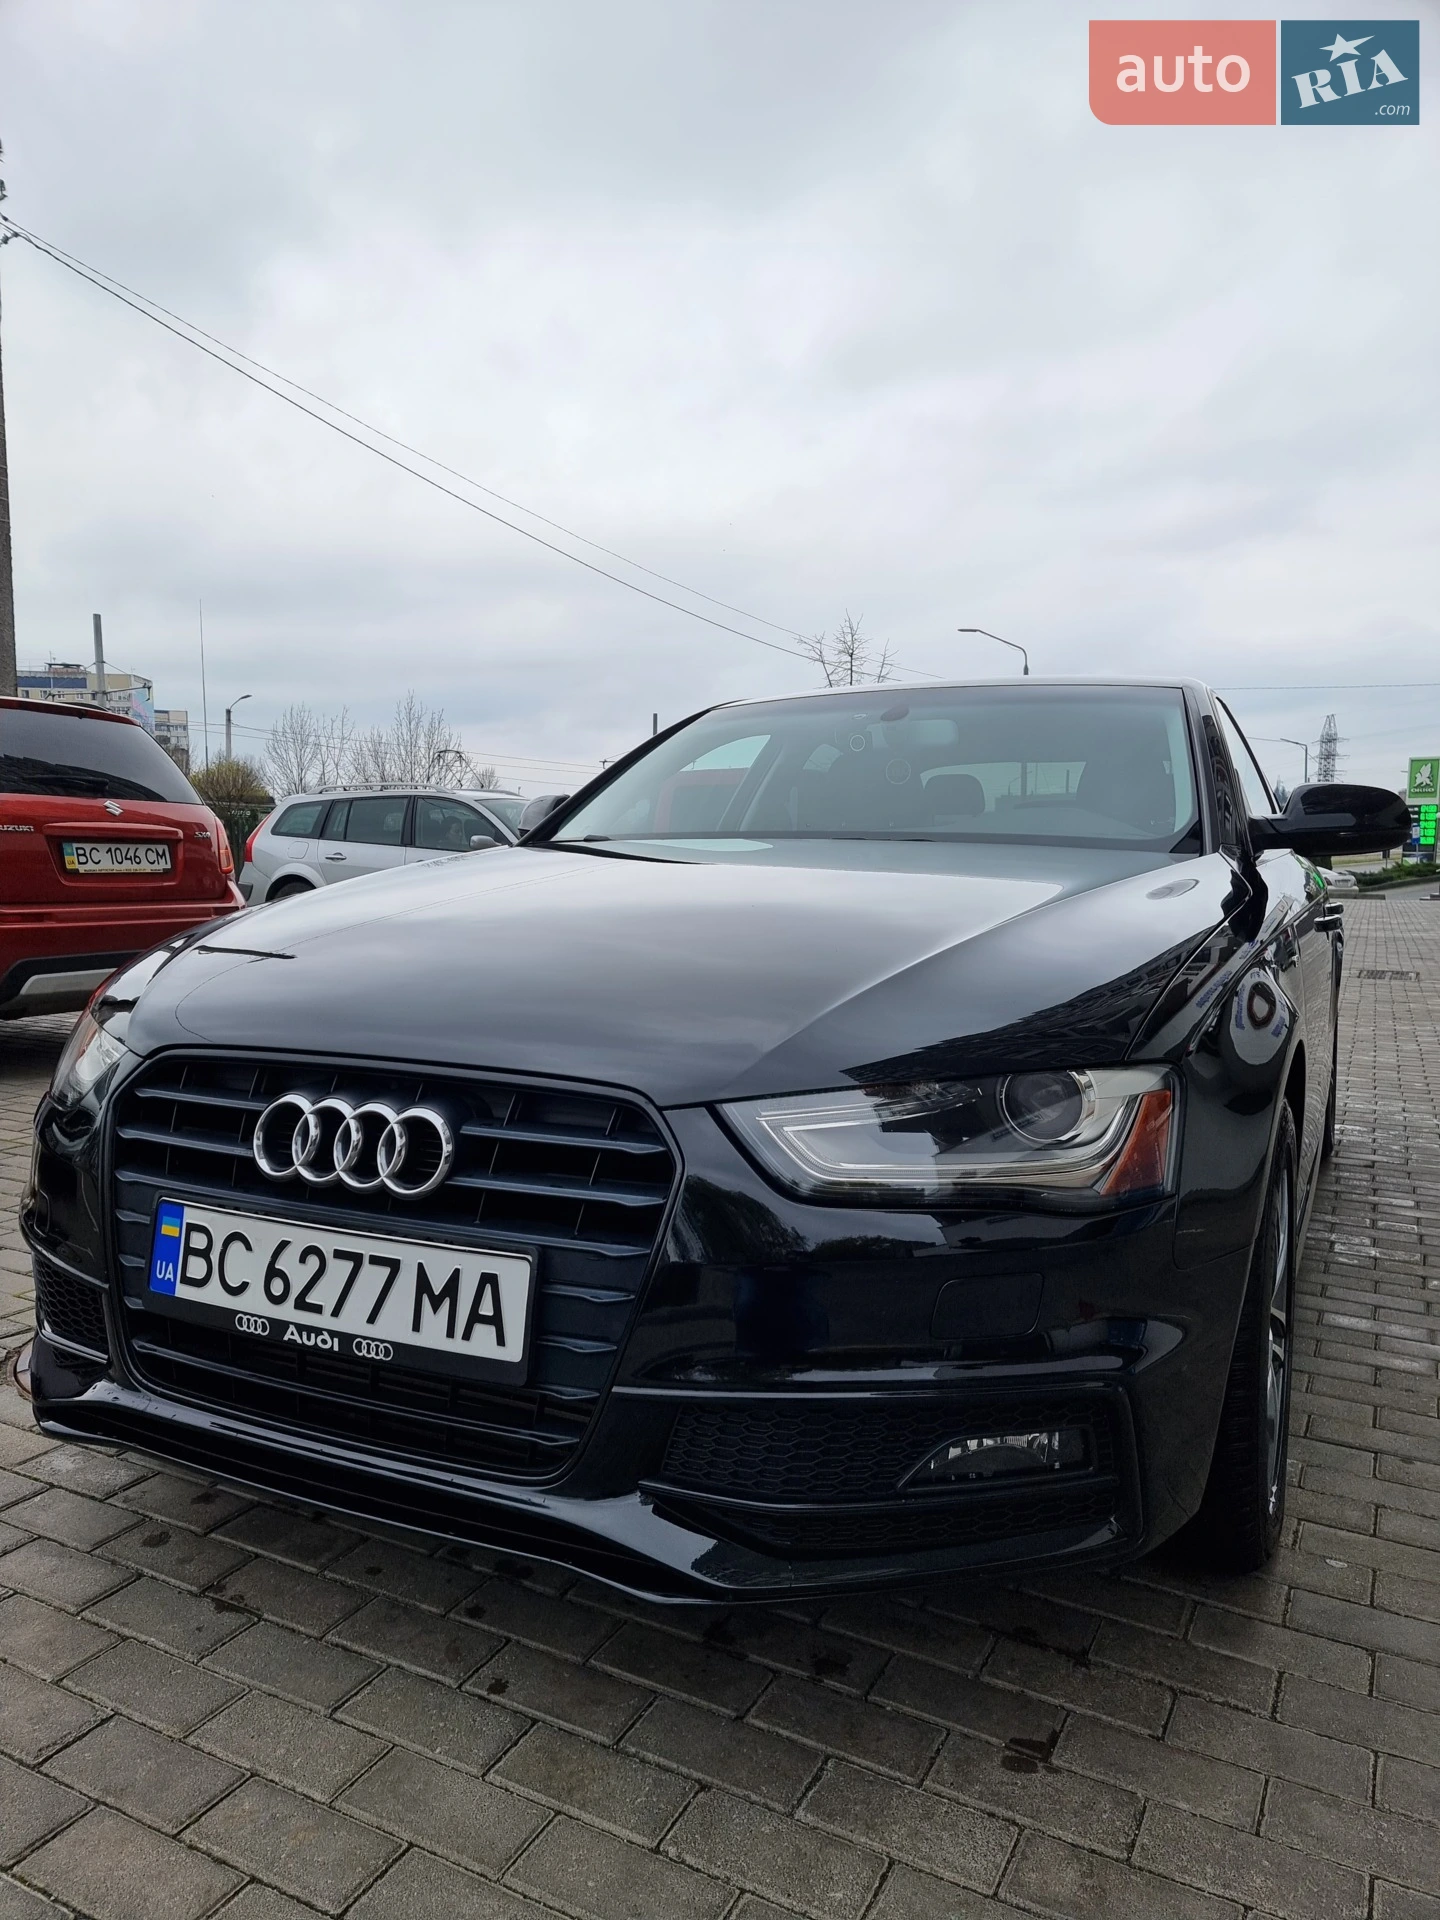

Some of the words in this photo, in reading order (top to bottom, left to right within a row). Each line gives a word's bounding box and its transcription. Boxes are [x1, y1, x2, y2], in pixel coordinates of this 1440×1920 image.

[75, 847, 101, 865] BC
[105, 848, 142, 865] 1046
[144, 848, 168, 865] CM
[156, 1260, 174, 1283] UA
[180, 1222, 253, 1297] BC
[262, 1240, 402, 1325] 6277
[411, 1262, 506, 1347] MA
[283, 1324, 339, 1351] Audi
